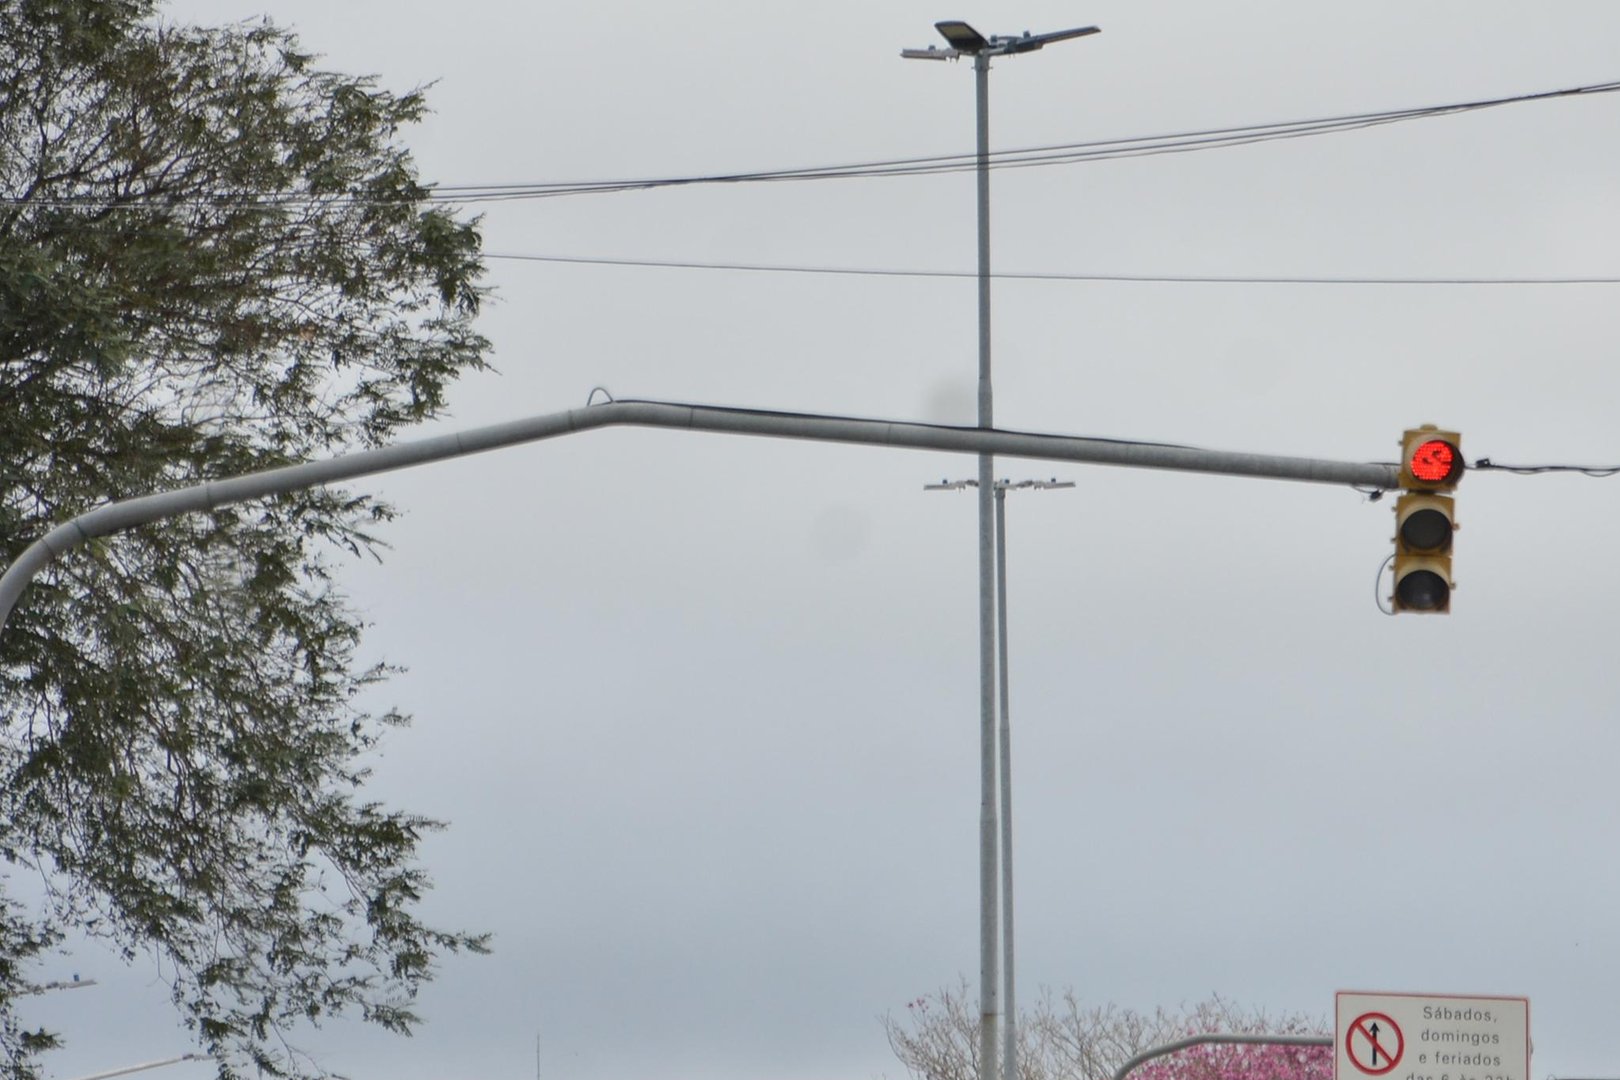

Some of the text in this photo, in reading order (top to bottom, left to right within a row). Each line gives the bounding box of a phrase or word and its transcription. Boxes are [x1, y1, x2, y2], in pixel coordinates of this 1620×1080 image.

[1423, 1006, 1498, 1023] Sábados,
[1420, 1029, 1500, 1046] domingos
[1419, 1051, 1501, 1067] e feriados
